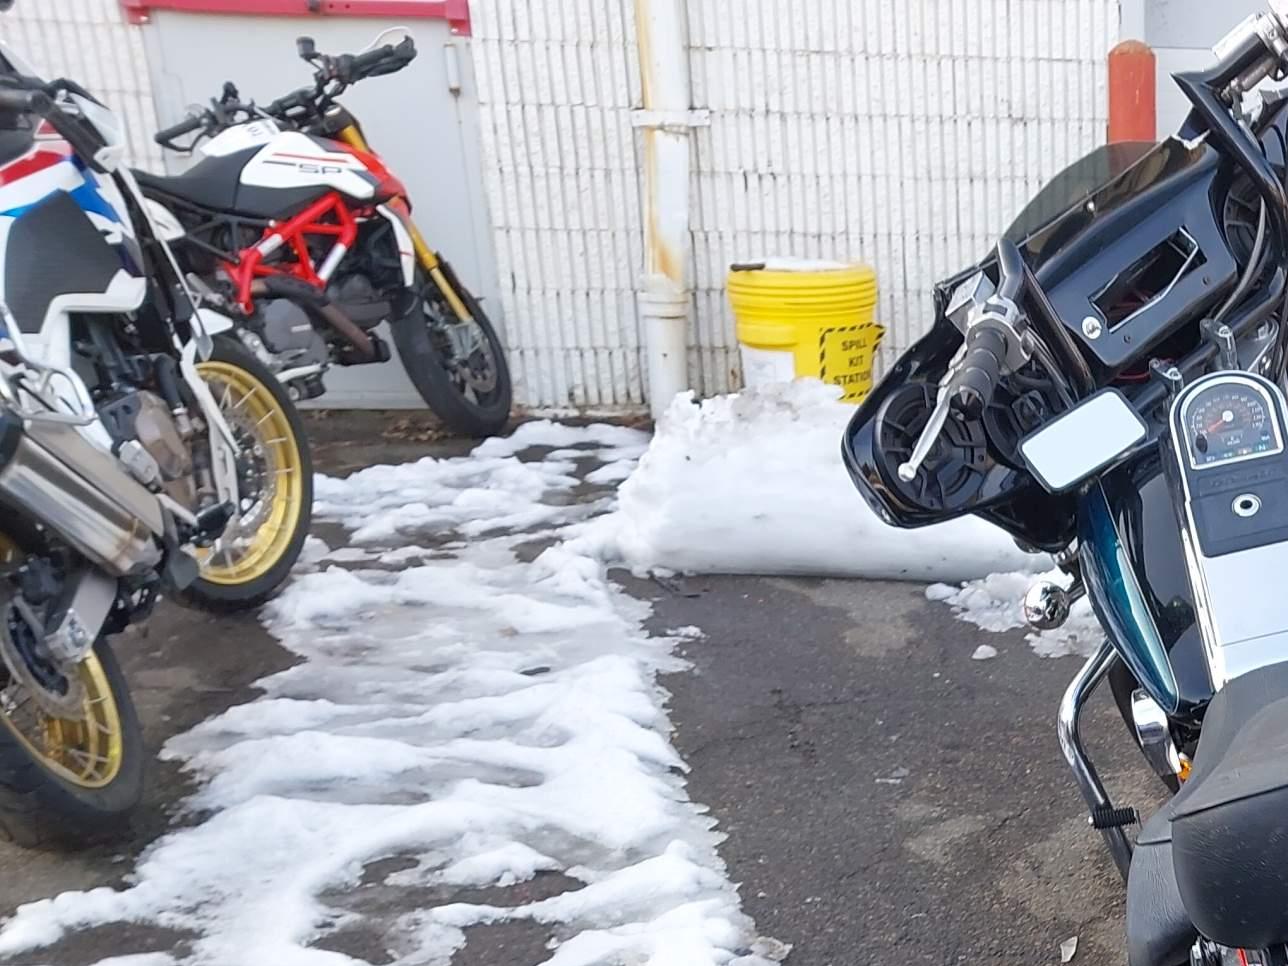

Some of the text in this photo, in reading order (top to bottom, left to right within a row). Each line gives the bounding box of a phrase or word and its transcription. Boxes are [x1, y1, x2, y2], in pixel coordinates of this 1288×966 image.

[299, 163, 342, 174] SP
[841, 337, 868, 351] SPILL
[848, 355, 864, 367] KIT
